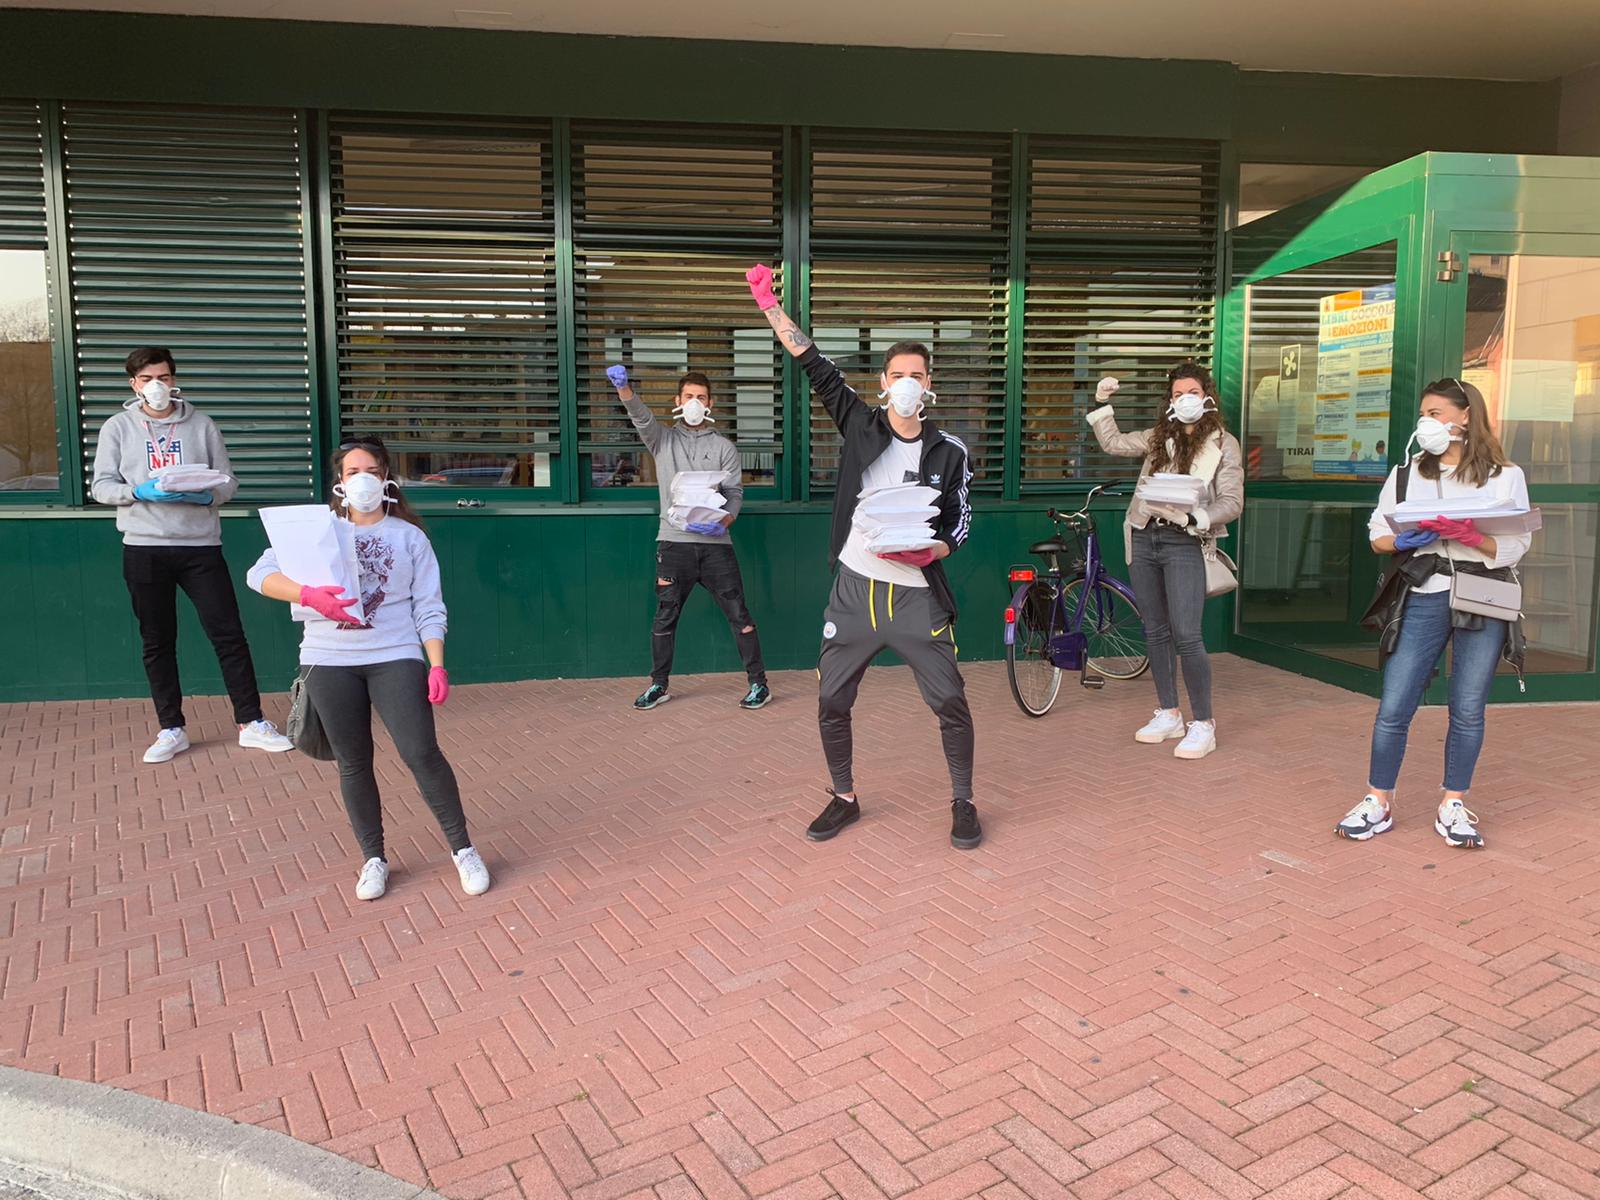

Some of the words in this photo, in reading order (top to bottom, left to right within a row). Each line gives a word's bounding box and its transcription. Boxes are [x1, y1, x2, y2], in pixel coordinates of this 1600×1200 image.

[1321, 311, 1349, 325] LIBRI
[1332, 317, 1388, 337] EMOZIONI
[1287, 448, 1314, 456] TIRA
[151, 453, 179, 470] NFL
